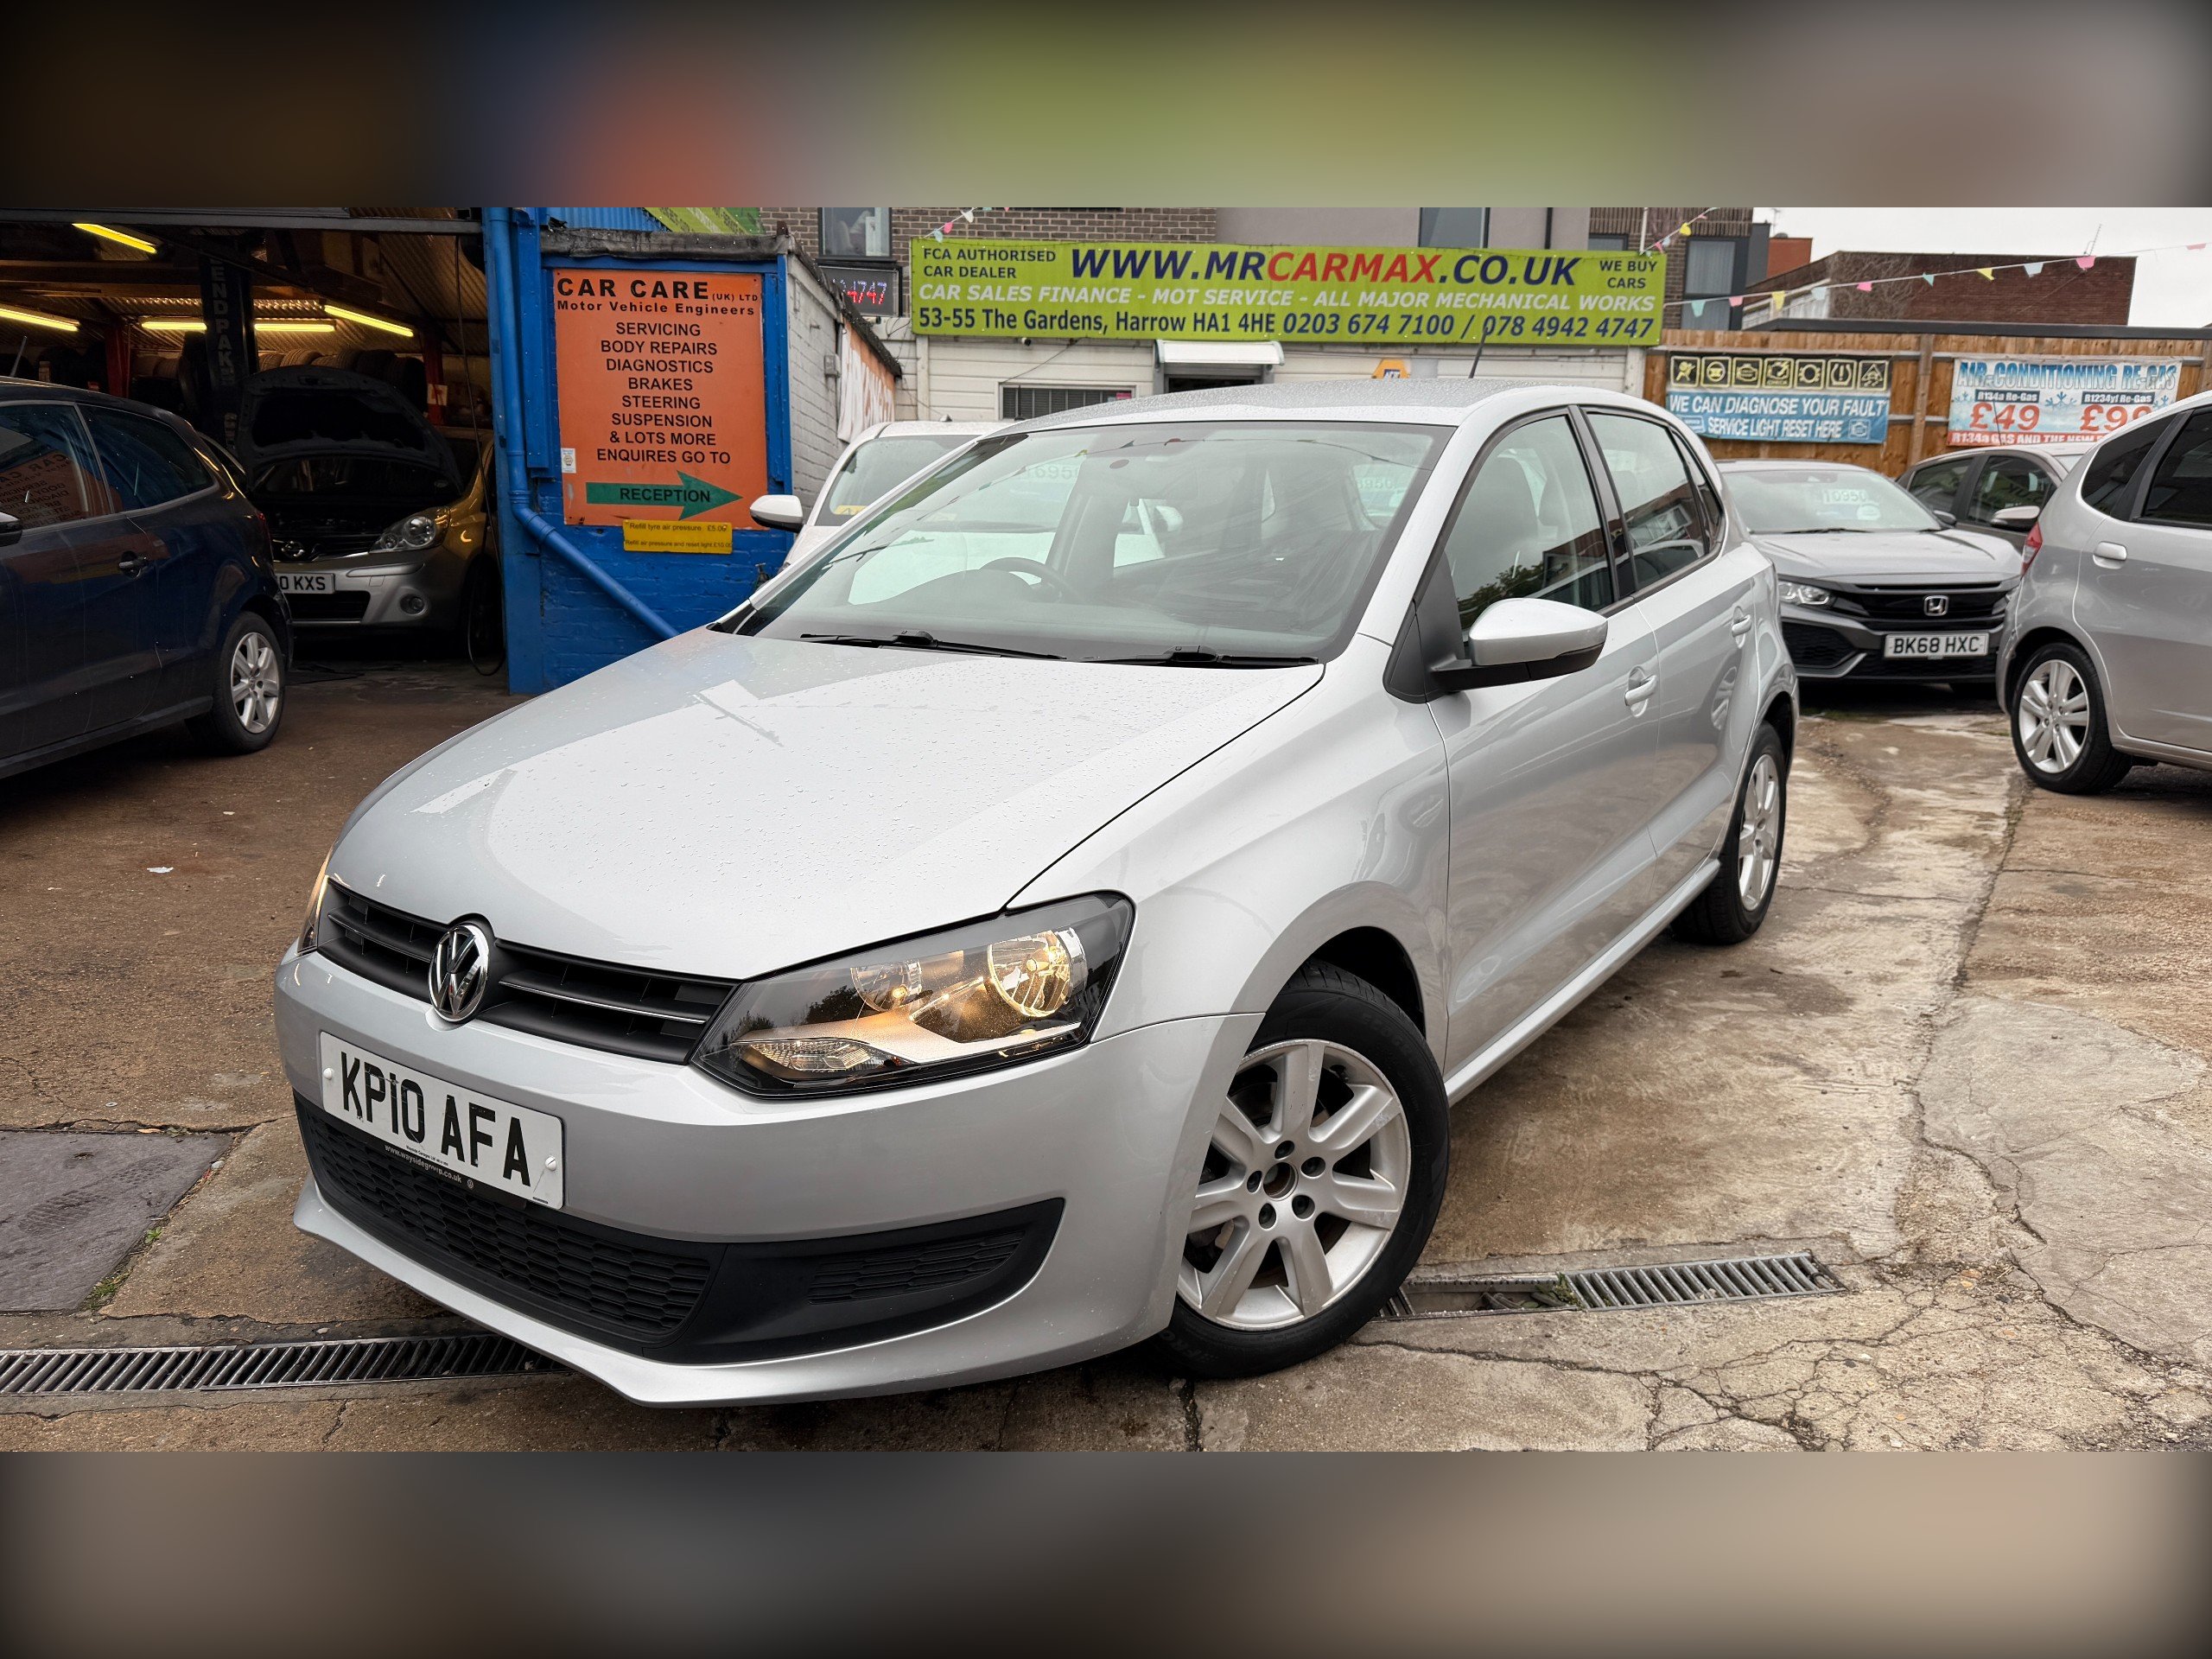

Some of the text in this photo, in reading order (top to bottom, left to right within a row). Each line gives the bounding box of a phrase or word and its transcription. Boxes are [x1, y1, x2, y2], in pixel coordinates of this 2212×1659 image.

[923, 248, 1057, 262] FCA AUTHORISED
[924, 265, 1017, 278] CAR DEALER
[1071, 248, 1582, 286] WWW.MRCARMAX.CO.UK
[1599, 259, 1657, 273] WE BUY
[557, 277, 759, 302] CAR CARE (UK) LTD
[1607, 276, 1646, 289] CARS
[918, 283, 961, 301] CAR
[967, 284, 1033, 302] SALES
[1038, 286, 1130, 303] FINANCE
[1153, 288, 1198, 305] MOT
[1203, 289, 1294, 307] SERVICE
[1313, 290, 1353, 308] ALL
[1358, 291, 1429, 308] MAJOR
[1434, 292, 1570, 311] MECHANICAL
[1579, 295, 1655, 312] WORKS
[208, 257, 235, 368] ENDPAK
[557, 300, 754, 316] Motor Vehicle Engineers
[616, 321, 701, 337] SERVICING
[918, 307, 1654, 339] 53-55 The Gardens, Harrow HA1 4HE 0203 674 7100 / 078 4942 4747
[601, 340, 717, 355] BODY REPAIRS
[606, 358, 714, 373] DIAGNOSTICS
[1957, 361, 2177, 391] AIR-CONDITIONING RE-GAS
[628, 378, 693, 391] BRAKES
[621, 395, 701, 410] STEERING
[1978, 391, 2005, 401] R134a
[2006, 391, 2038, 402] Re-Gas
[2121, 394, 2152, 404] Re-Gas
[1669, 396, 1689, 413] WE
[1692, 396, 1721, 413] CAN
[1725, 397, 1798, 415] DIAGNOSE
[1802, 397, 1840, 416] YOUR
[612, 412, 712, 428] SUSPENSION
[1969, 403, 2040, 431] £49
[1707, 416, 1750, 435] SERVICE
[1750, 417, 1781, 437] LIGHT
[1783, 419, 1815, 438] RESET
[1815, 420, 1844, 438] HERE
[610, 430, 715, 446] & LOTS MORE
[1991, 433, 2015, 444] GAS
[2017, 434, 2041, 444] AND
[597, 448, 730, 464] ENQUIRES GO TO
[620, 486, 711, 502] RECEPTION
[647, 523, 661, 531] tyre
[294, 575, 326, 590] KXS
[1892, 636, 1980, 654] BK68 HXC
[340, 1051, 531, 1187] KP10 AFA
